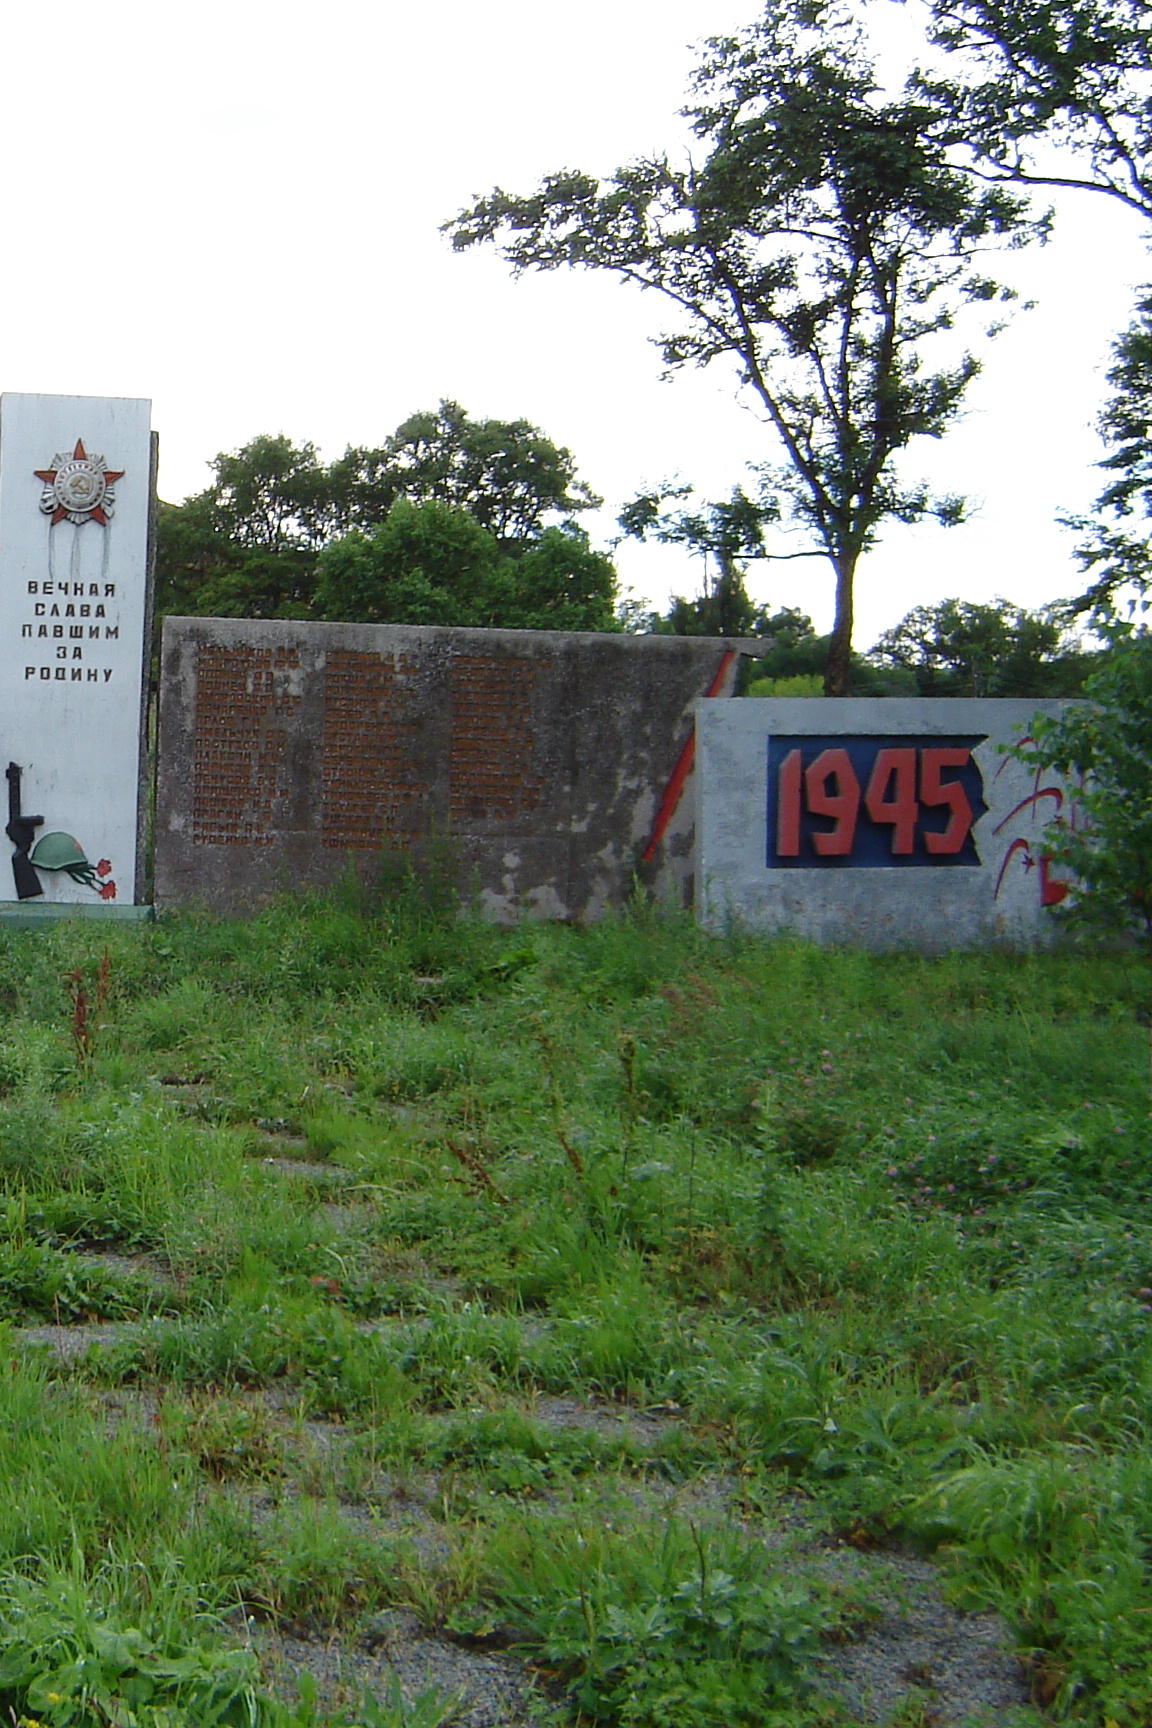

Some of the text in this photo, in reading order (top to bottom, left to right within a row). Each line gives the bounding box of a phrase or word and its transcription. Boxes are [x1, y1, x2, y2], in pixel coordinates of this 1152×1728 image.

[27, 581, 116, 598] ВЕЧНАЯ
[34, 603, 107, 619] СЛАВА
[21, 624, 120, 641] ПАВШИМ
[56, 647, 83, 661] ЗА
[25, 667, 114, 684] РОДИНУ
[776, 747, 974, 856] 1945
